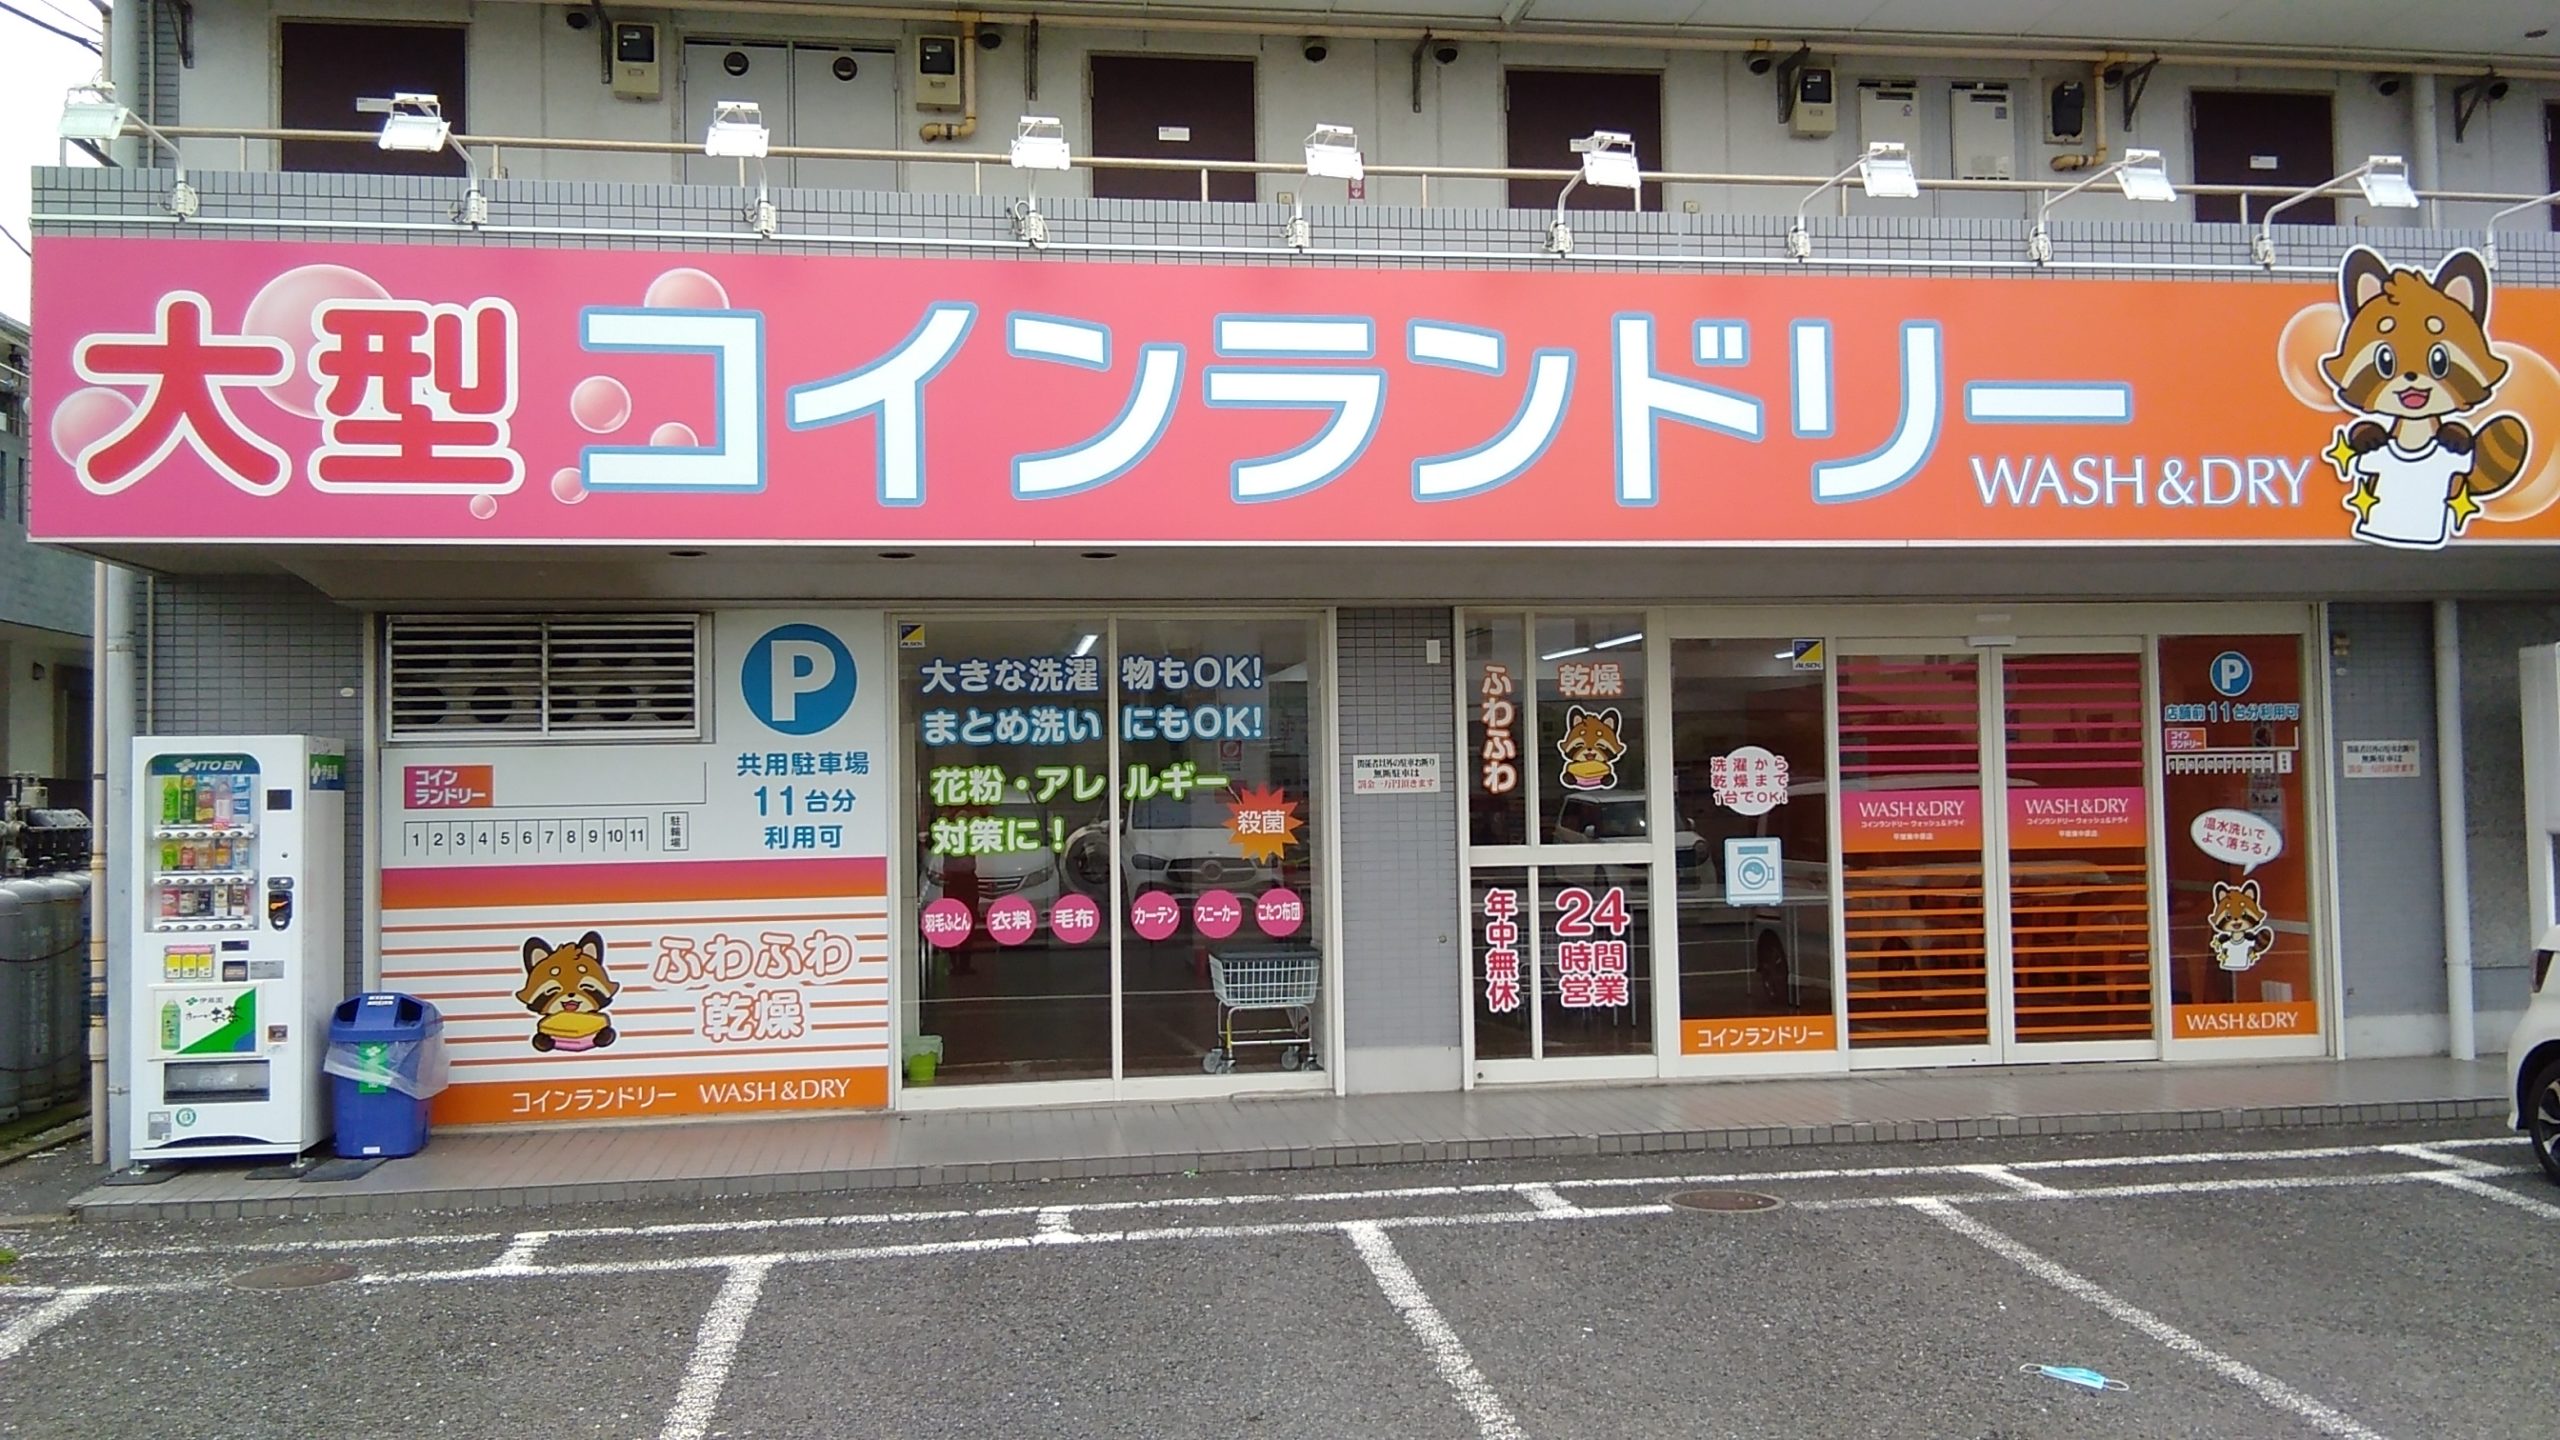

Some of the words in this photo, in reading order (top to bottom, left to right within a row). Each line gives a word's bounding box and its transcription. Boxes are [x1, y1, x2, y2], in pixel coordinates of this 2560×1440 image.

[74, 289, 525, 496] 大型
[580, 301, 2131, 507] コインランドリー
[771, 639, 836, 722] P
[1559, 663, 1622, 697] 乾燥
[2221, 658, 2244, 690] P
[1481, 664, 1517, 793] ふわふわ
[416, 768, 458, 786] コイン
[736, 751, 870, 777] 共用駐車場
[1711, 756, 1789, 773] 洗濯から
[415, 787, 486, 805] ランドリー
[1711, 773, 1789, 790] 乾燥まで
[753, 785, 857, 817] 11台分
[1713, 790, 1789, 806] 1台でOK!
[412, 833, 420, 847] 1
[433, 832, 443, 847] 2
[456, 832, 466, 846] 3
[478, 831, 488, 846] 4
[500, 831, 511, 845] 5
[522, 830, 532, 845] 6
[544, 830, 554, 844] 7
[566, 830, 576, 844] 8
[588, 829, 598, 843] 9
[607, 829, 624, 843] 10
[630, 828, 644, 842] 11
[764, 824, 844, 850] 利用可
[1237, 810, 1286, 834] 殺菌
[2203, 816, 2266, 840] 温水洗いで
[924, 912, 971, 933] 羽毛ふとん
[991, 909, 1032, 931] 衣料
[1055, 908, 1094, 929] 毛布
[1134, 906, 1178, 925] カーテン
[1197, 904, 1240, 923] スニーカー
[1258, 901, 1300, 922] こたつ布団
[1556, 886, 1631, 936] 24
[653, 928, 853, 983] ふわふわ
[1485, 887, 1520, 1013] 年中無休
[1559, 941, 1627, 973] 時間
[1559, 974, 1628, 1008] 営業
[702, 988, 805, 1043] 乾燥
[1697, 1025, 1824, 1048] コインランドリー
[511, 1086, 677, 1114] コインランドリー
